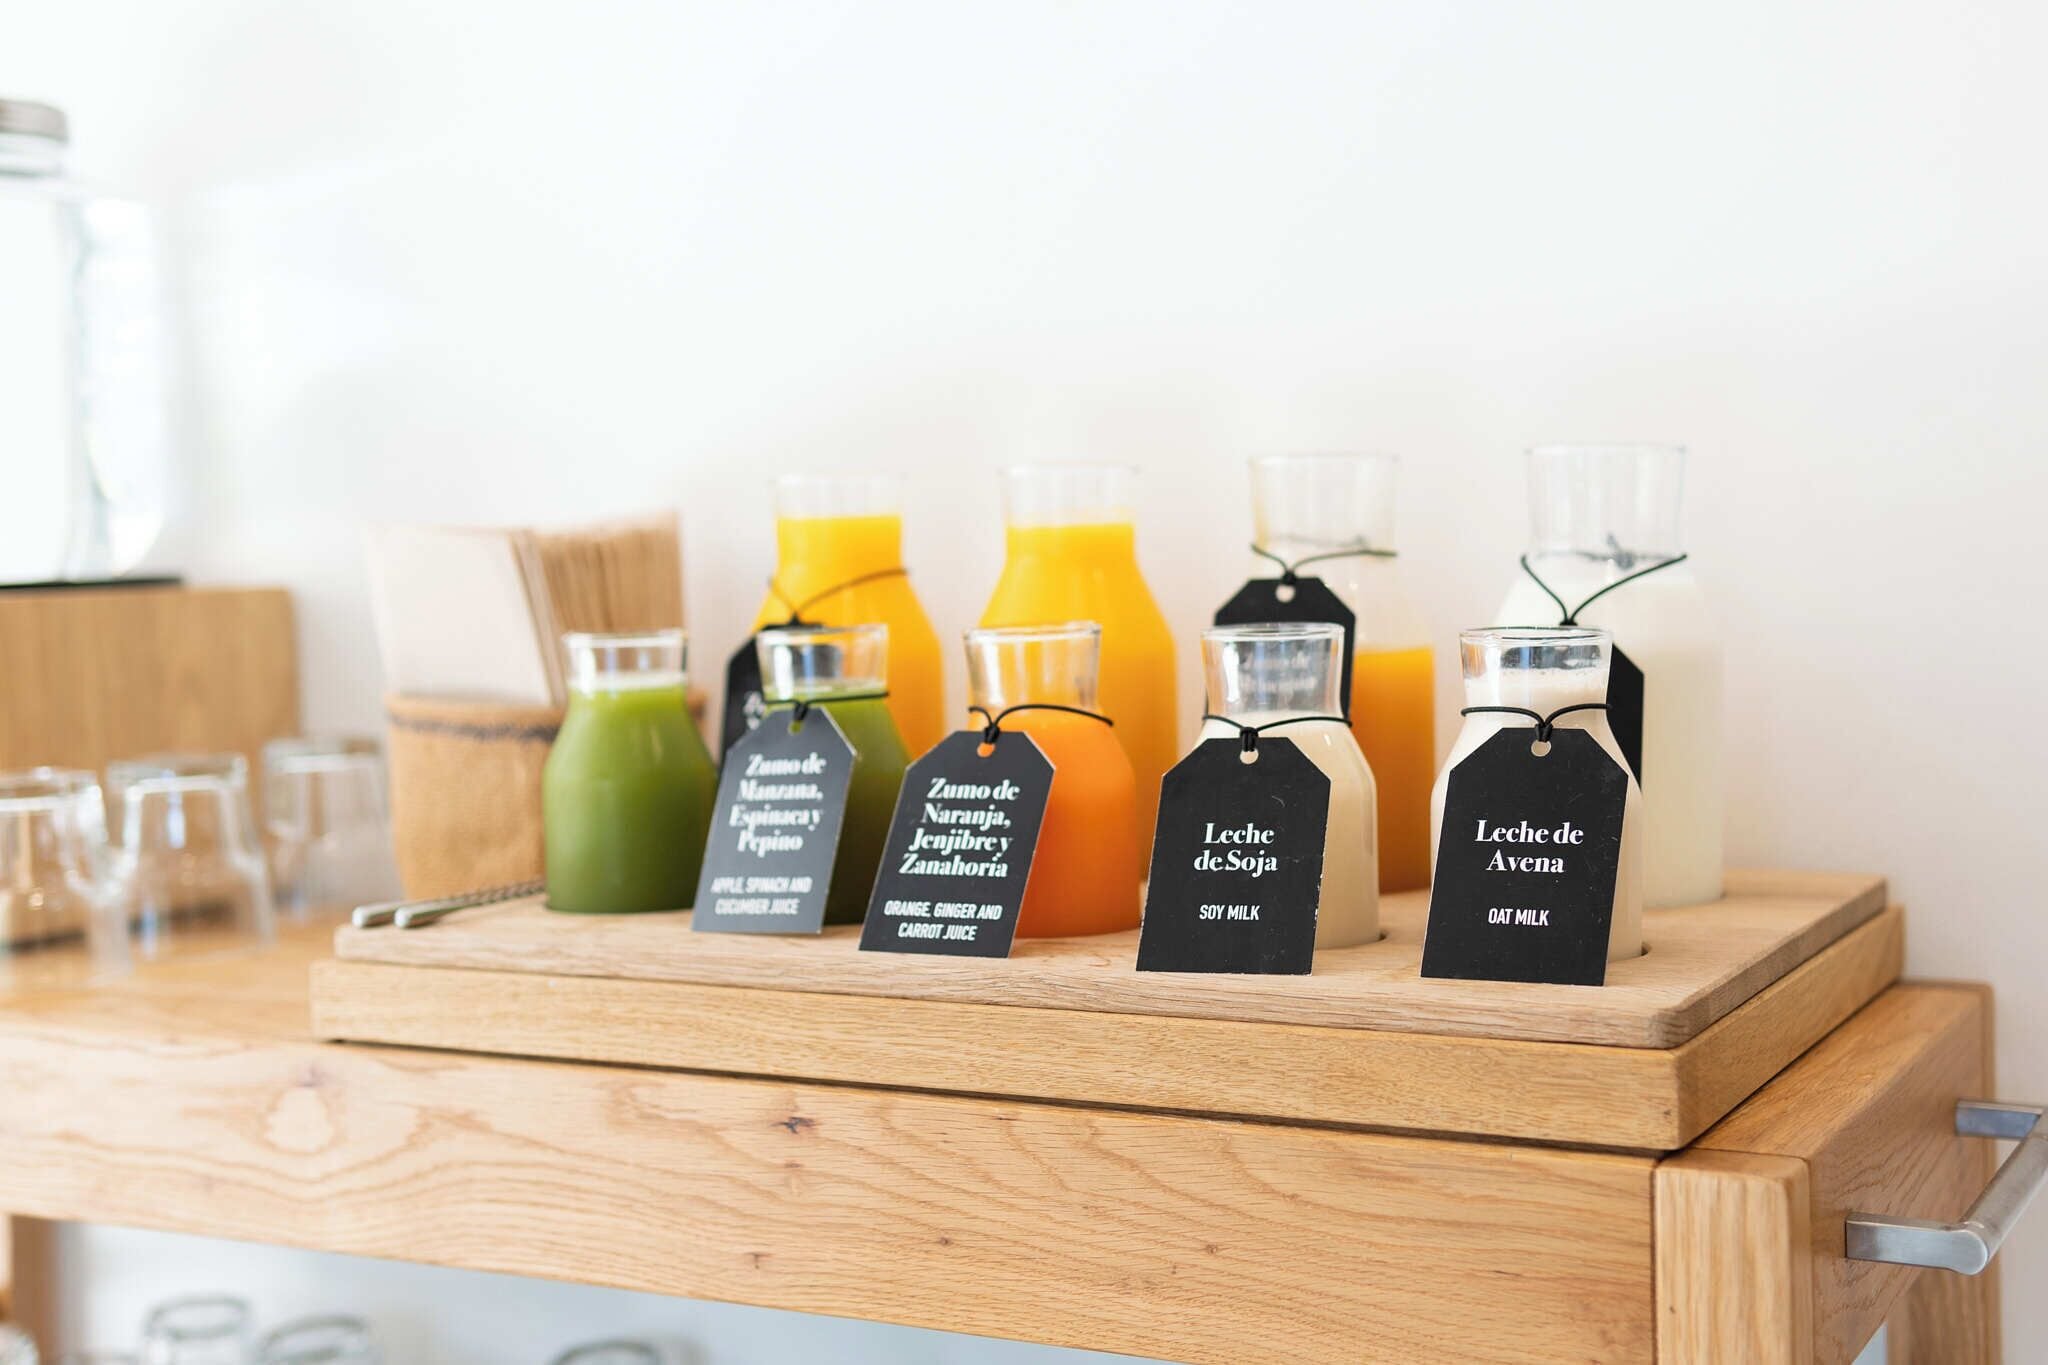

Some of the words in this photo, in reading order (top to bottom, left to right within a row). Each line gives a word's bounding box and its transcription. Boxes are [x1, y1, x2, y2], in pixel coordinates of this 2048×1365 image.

[746, 754, 801, 776] Zumo
[927, 778, 991, 799] Zumo
[992, 779, 1020, 800] de
[921, 803, 1011, 831] Naranja,
[737, 829, 803, 857] Pepino
[908, 828, 998, 856] Jenjibre
[996, 837, 1013, 858] y
[1203, 822, 1275, 844] Leche
[1475, 819, 1549, 844] Leche
[1552, 821, 1585, 845] de
[898, 853, 1009, 877] Zanahoria
[1193, 849, 1224, 872] de
[1224, 849, 1279, 878] Soja
[1485, 848, 1565, 873] Avena
[768, 899, 799, 914] JUICE
[933, 902, 977, 920] GINGER
[976, 904, 1003, 920] AND
[1199, 904, 1226, 920] SOY
[1226, 904, 1261, 921] MILK
[1487, 907, 1514, 925] OAT
[1514, 908, 1550, 926] MILK
[898, 922, 944, 939] CARROT
[942, 925, 978, 941] JUICE
